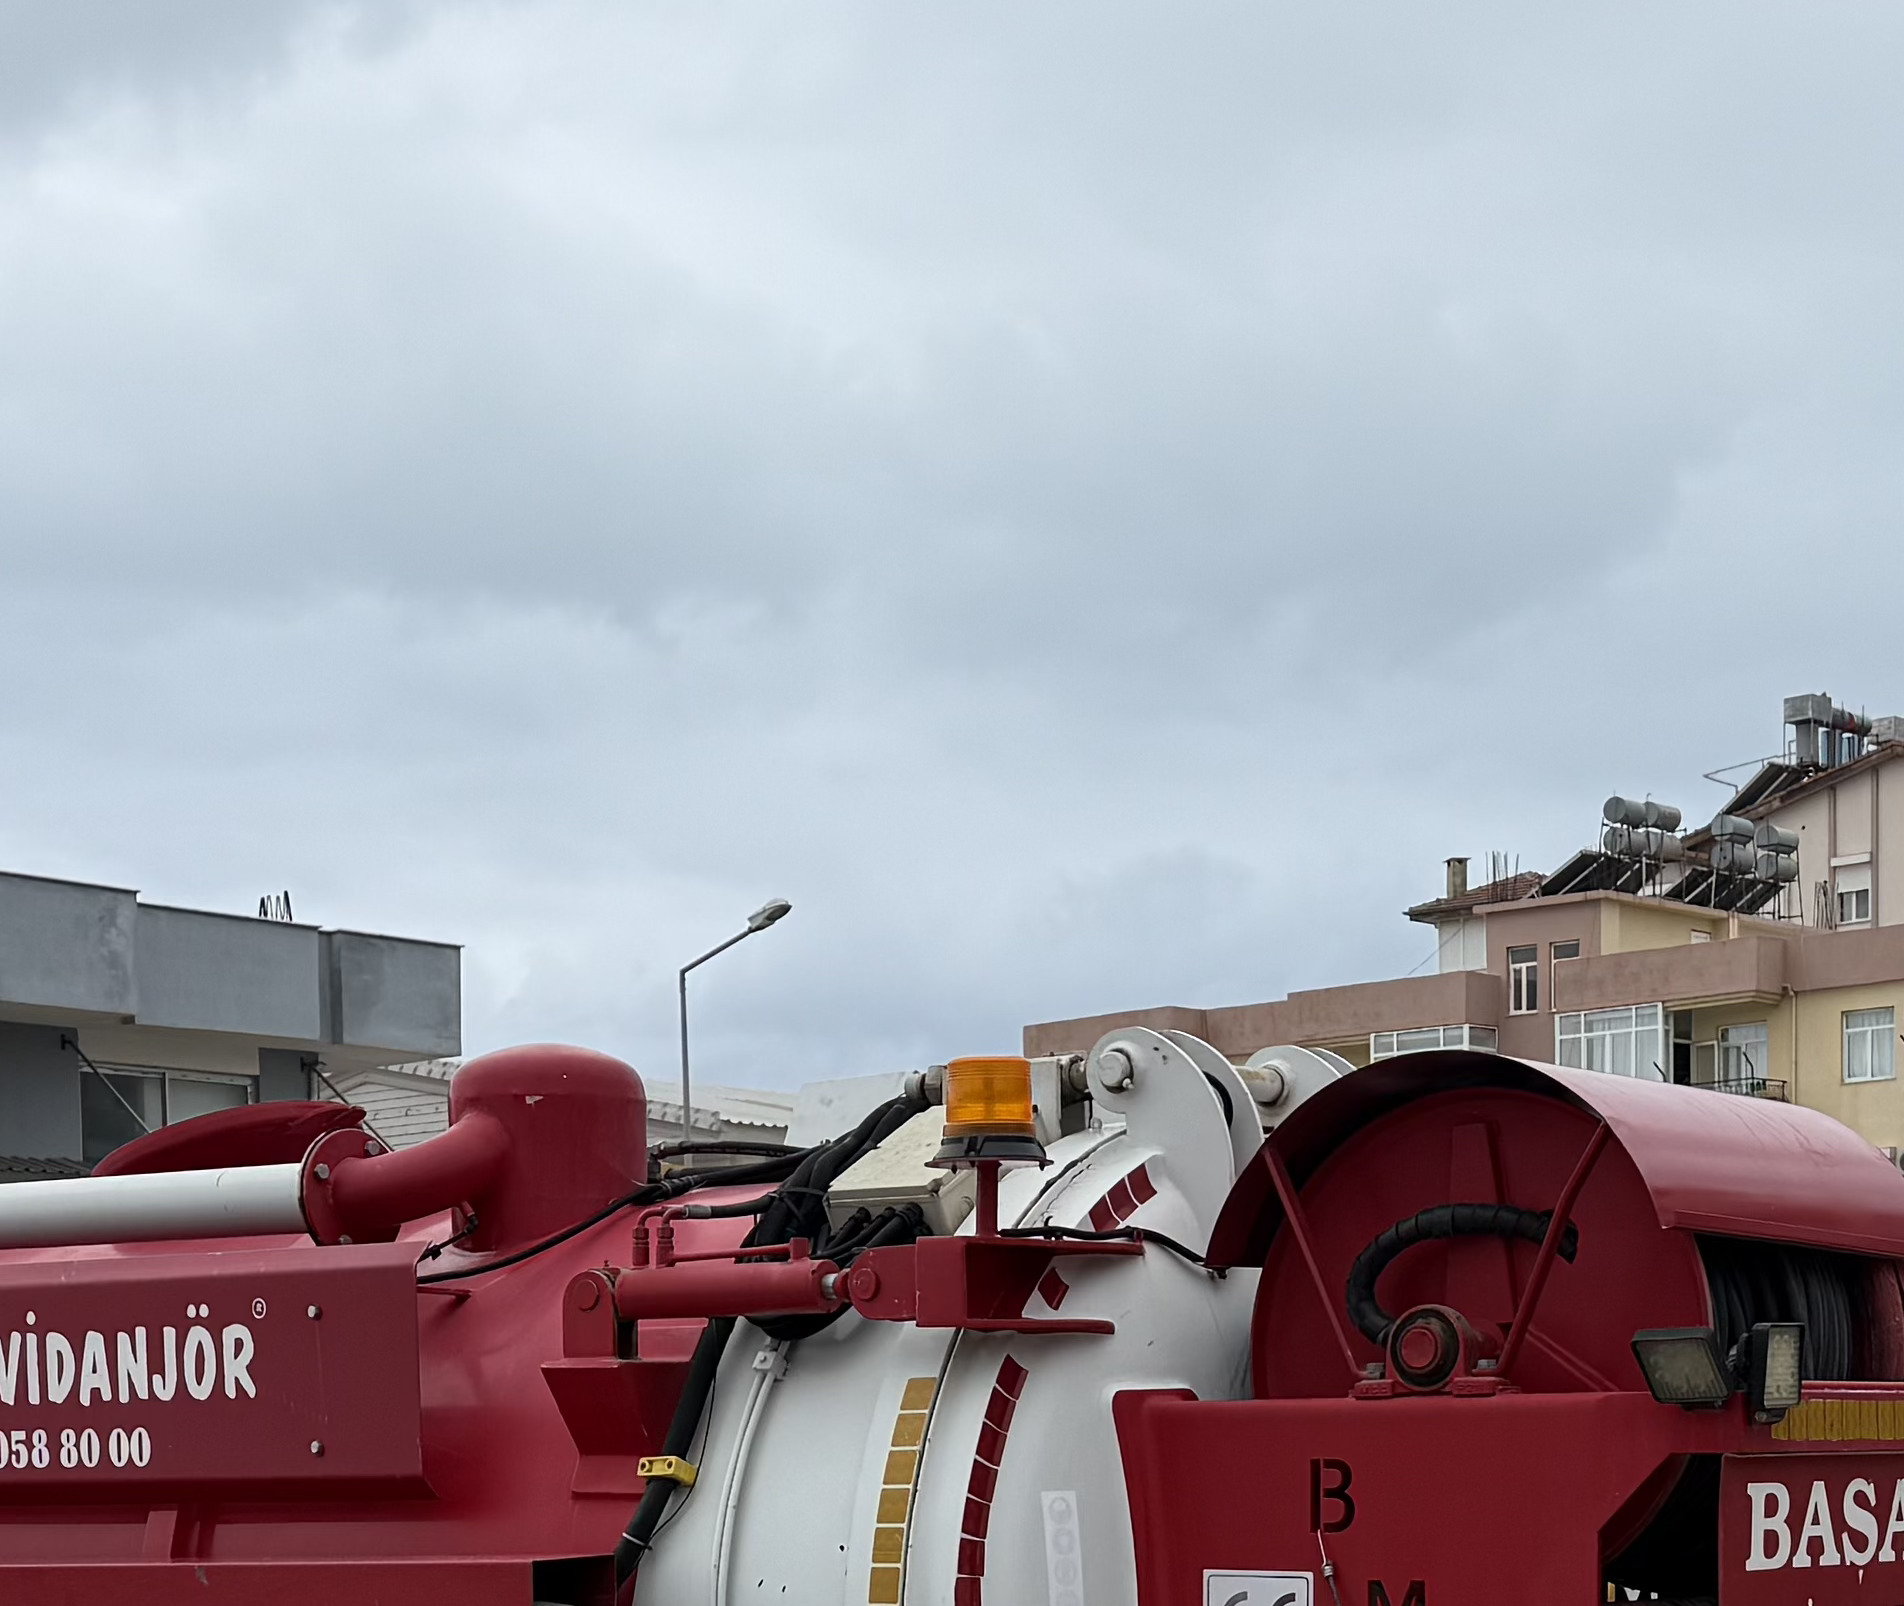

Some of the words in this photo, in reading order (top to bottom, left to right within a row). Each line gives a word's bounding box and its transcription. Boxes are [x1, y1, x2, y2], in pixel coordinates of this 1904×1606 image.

[59, 1427, 101, 1468] 80
[108, 1426, 152, 1468] 00
[1309, 1457, 1356, 1534] B
